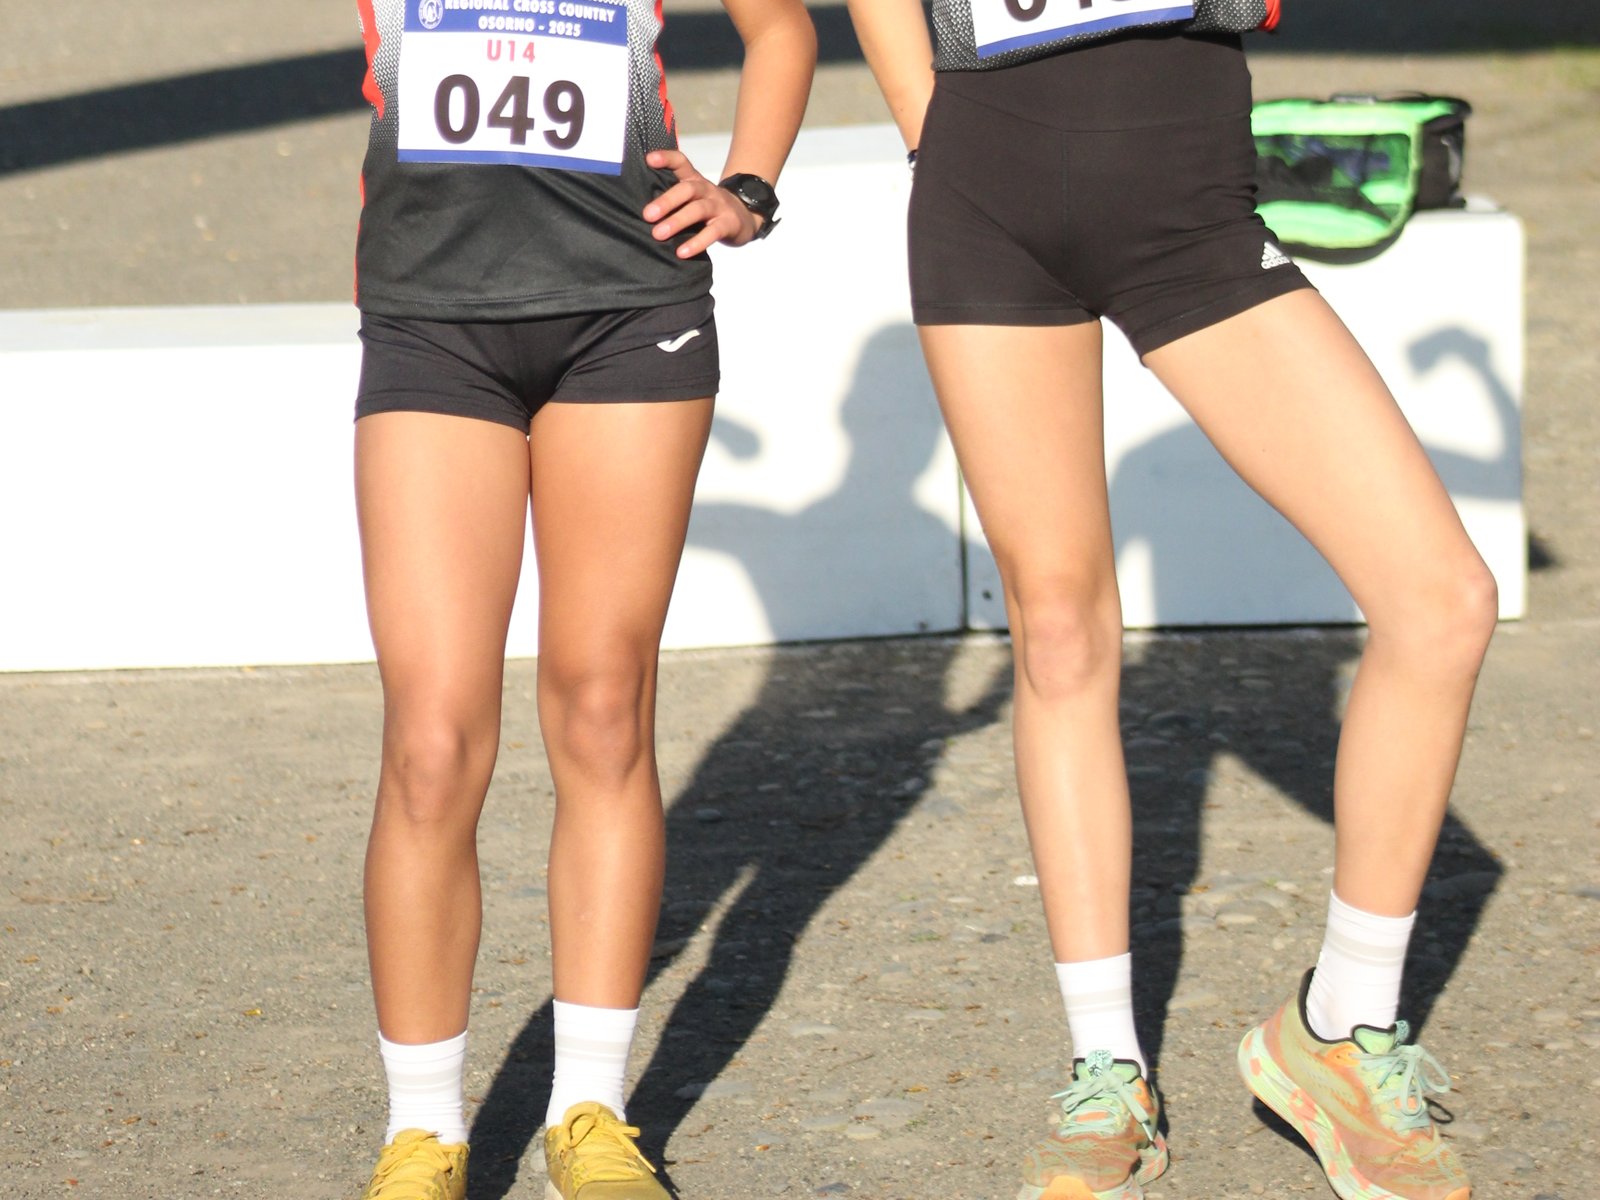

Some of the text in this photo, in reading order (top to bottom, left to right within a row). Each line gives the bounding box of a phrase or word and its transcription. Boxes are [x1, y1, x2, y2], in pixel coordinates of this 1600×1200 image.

[558, 1, 616, 23] COUNTRY
[478, 15, 535, 32] OSORNO
[548, 20, 582, 38] 2025
[486, 39, 536, 63] U14
[433, 73, 586, 151] 049
[1260, 255, 1290, 270] adida
